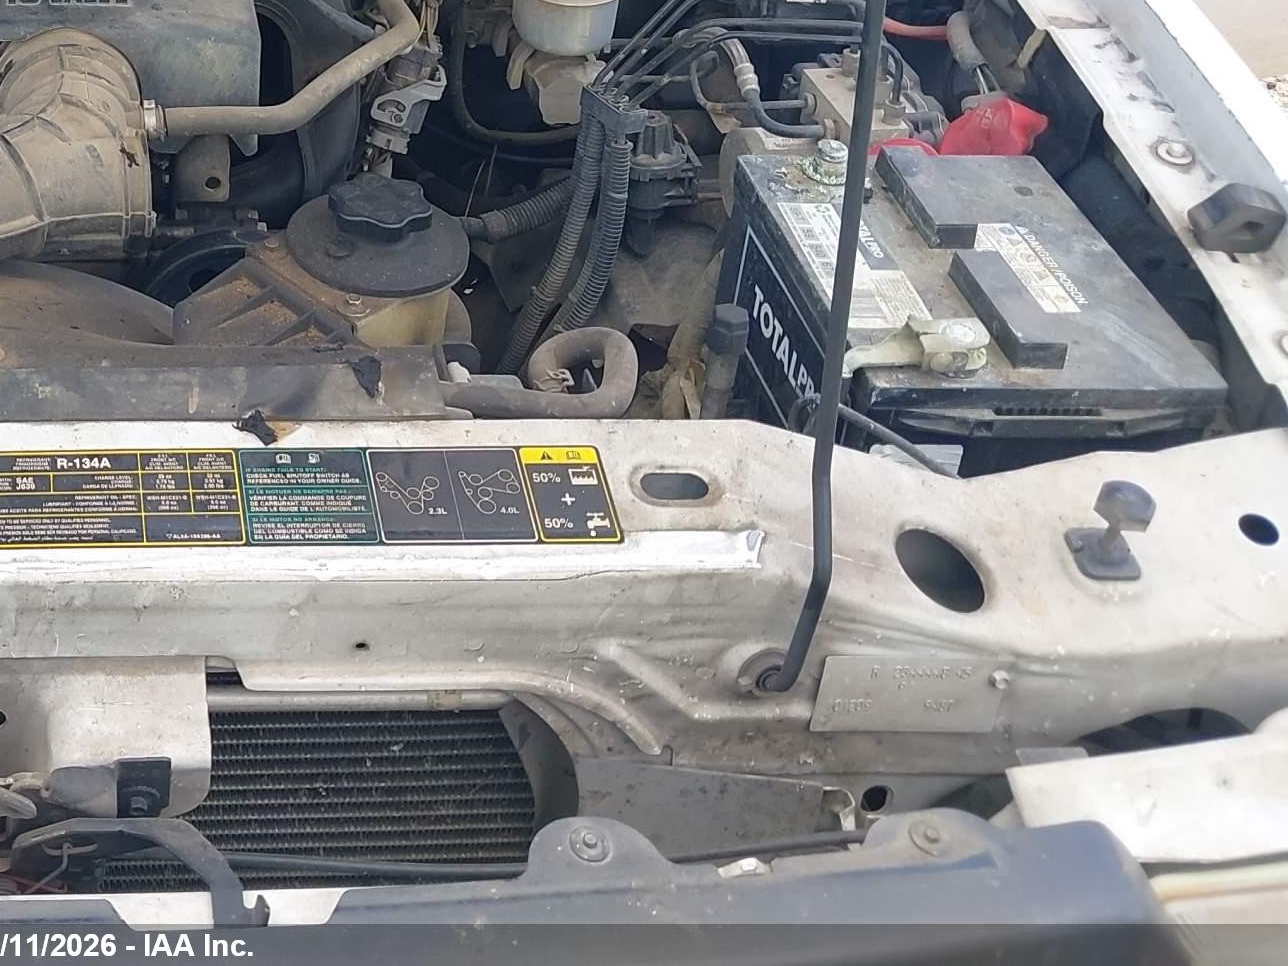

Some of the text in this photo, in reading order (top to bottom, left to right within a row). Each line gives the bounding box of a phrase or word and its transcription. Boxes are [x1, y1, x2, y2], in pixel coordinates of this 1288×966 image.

[1024, 234, 1058, 270] DANGER
[1057, 272, 1088, 304] POISON
[56, 458, 112, 470] R-134A
[532, 473, 561, 483] 50%
[544, 517, 574, 529] 50%
